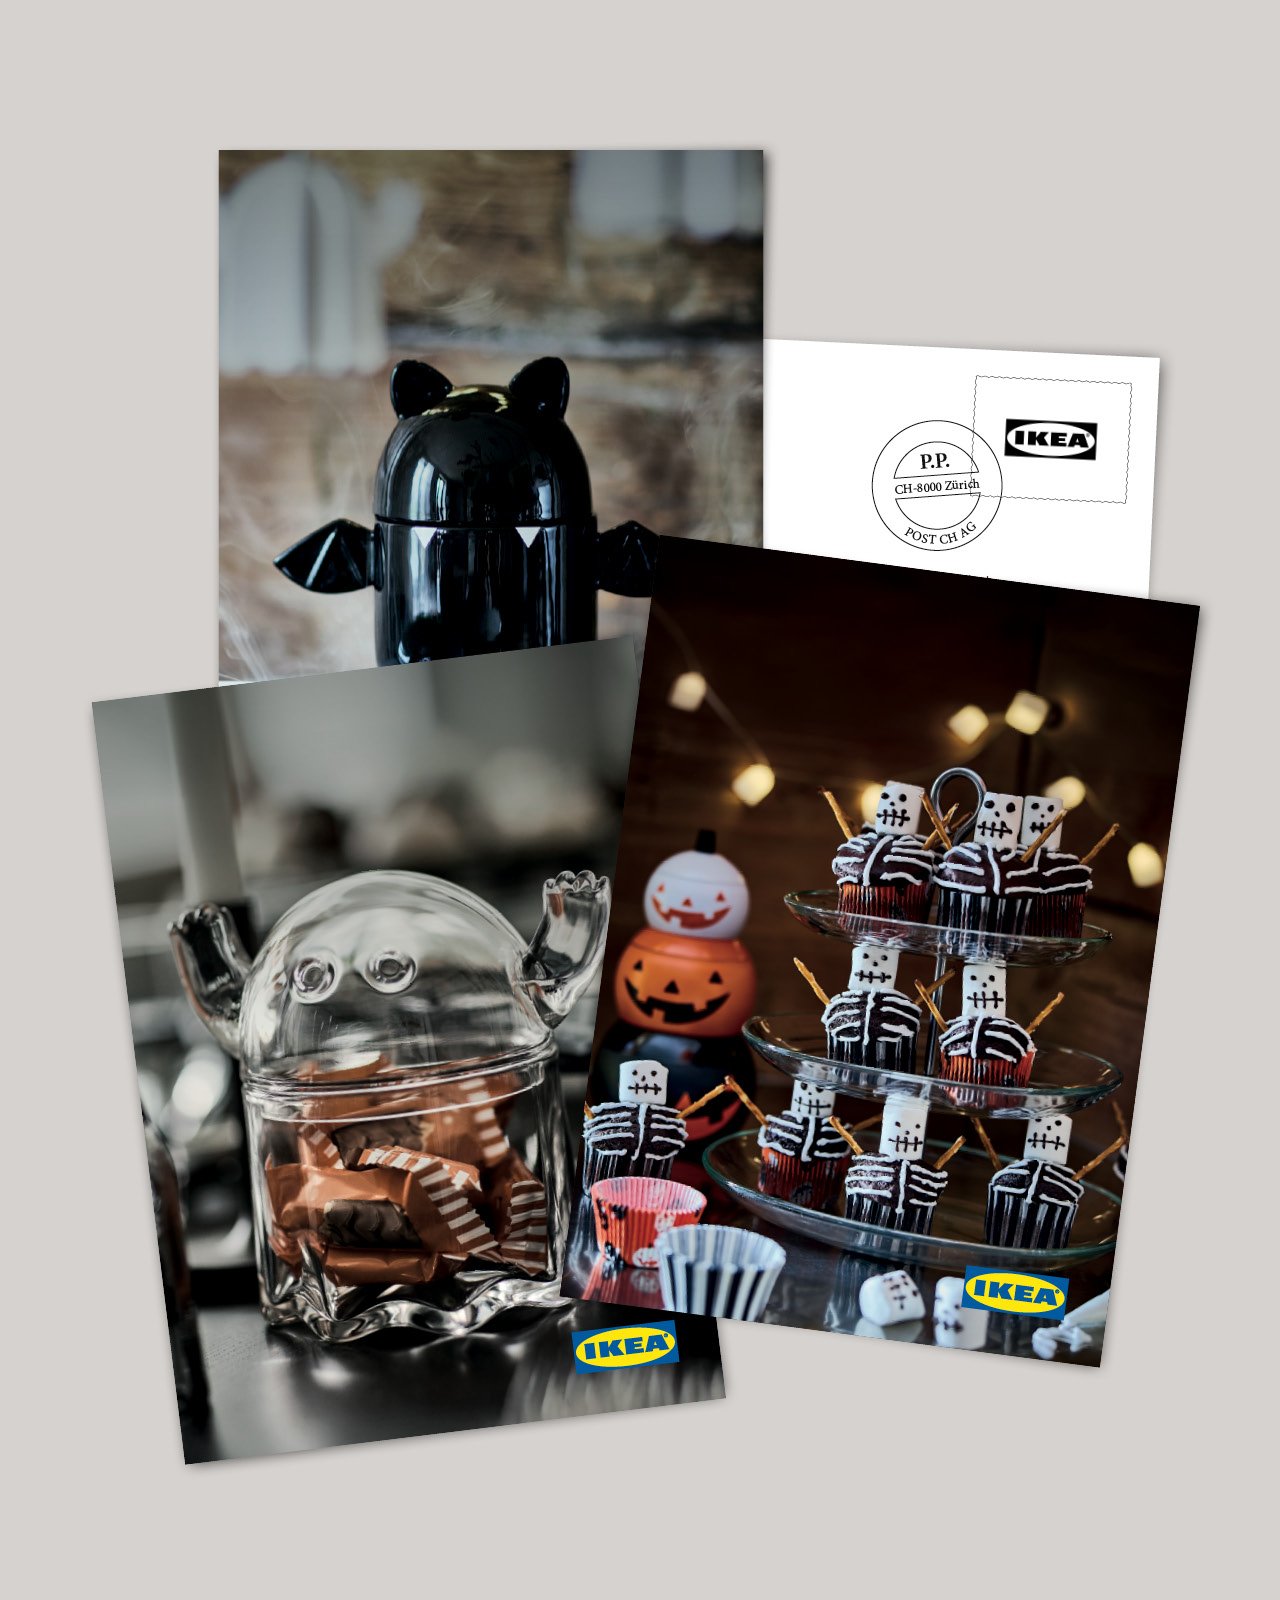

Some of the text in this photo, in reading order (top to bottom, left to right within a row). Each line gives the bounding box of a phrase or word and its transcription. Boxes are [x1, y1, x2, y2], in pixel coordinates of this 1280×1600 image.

[1014, 430, 1089, 448] IKEA
[919, 452, 950, 470] P.P.
[894, 478, 980, 495] CH-8000 Zürich
[904, 521, 977, 545] POST CH AG
[973, 1278, 1058, 1307] IKEA
[583, 1333, 670, 1361] IKEA
